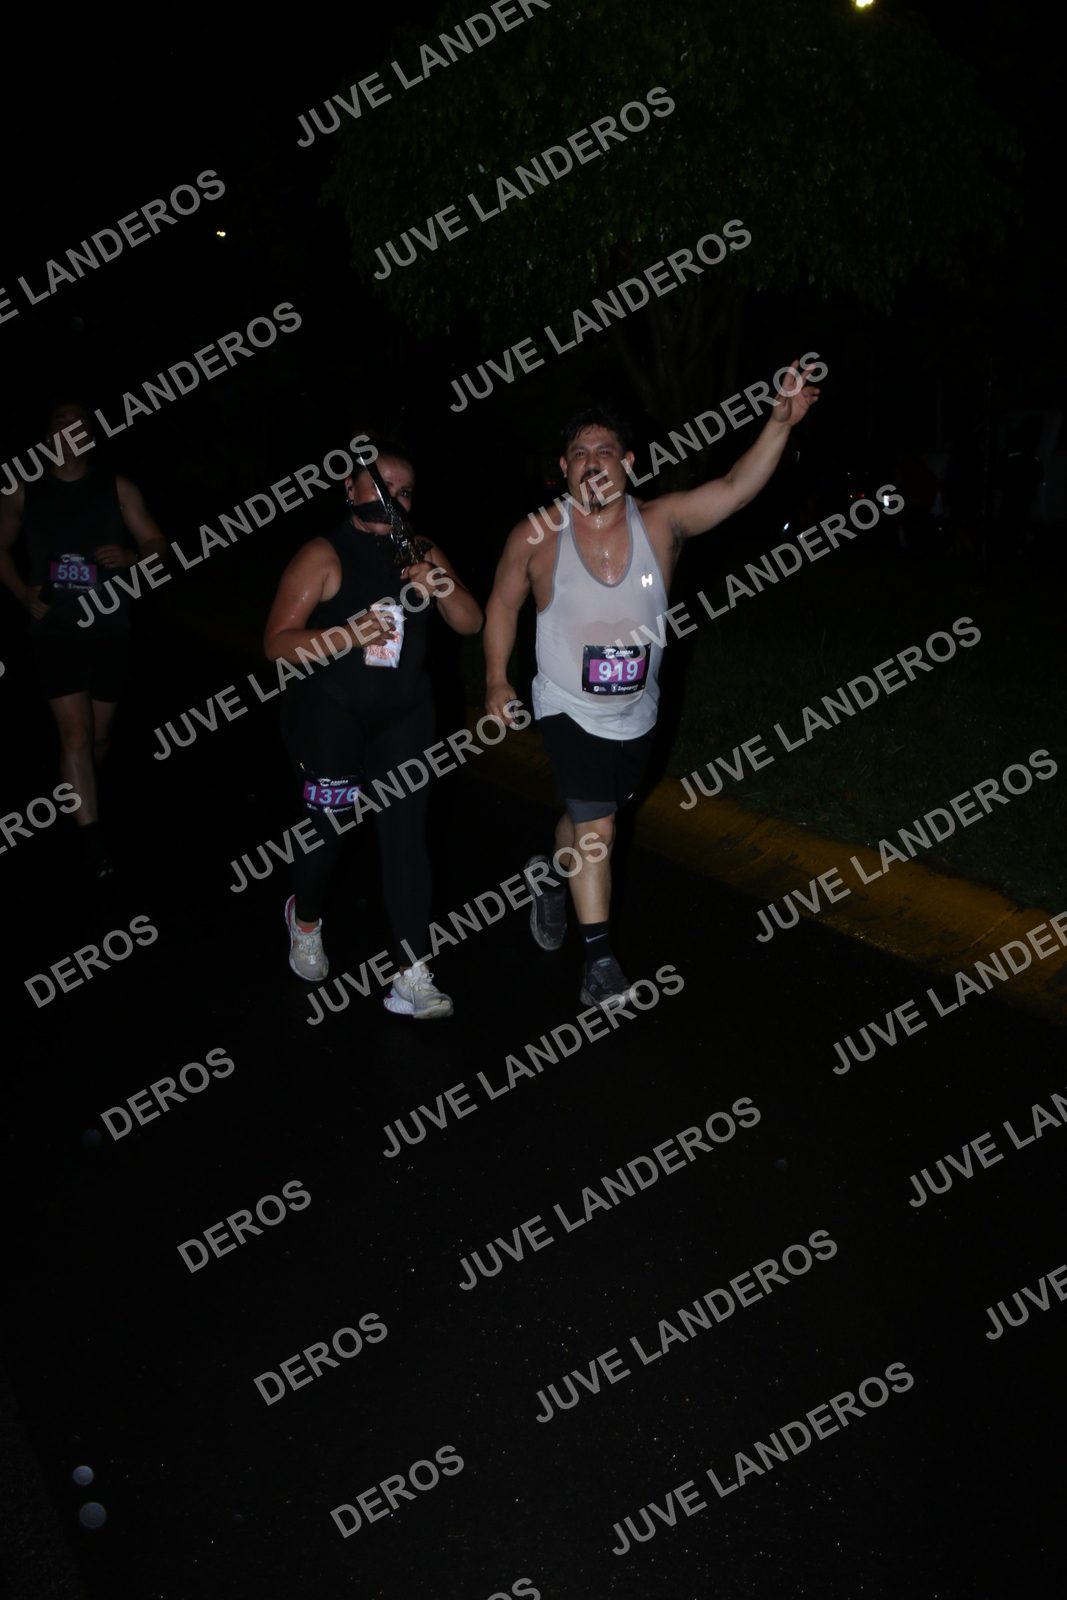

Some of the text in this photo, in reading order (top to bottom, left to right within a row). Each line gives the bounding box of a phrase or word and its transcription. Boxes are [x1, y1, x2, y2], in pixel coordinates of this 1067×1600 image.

[57, 564, 90, 581] 583
[598, 660, 639, 682] 919
[307, 784, 359, 805] 1376
